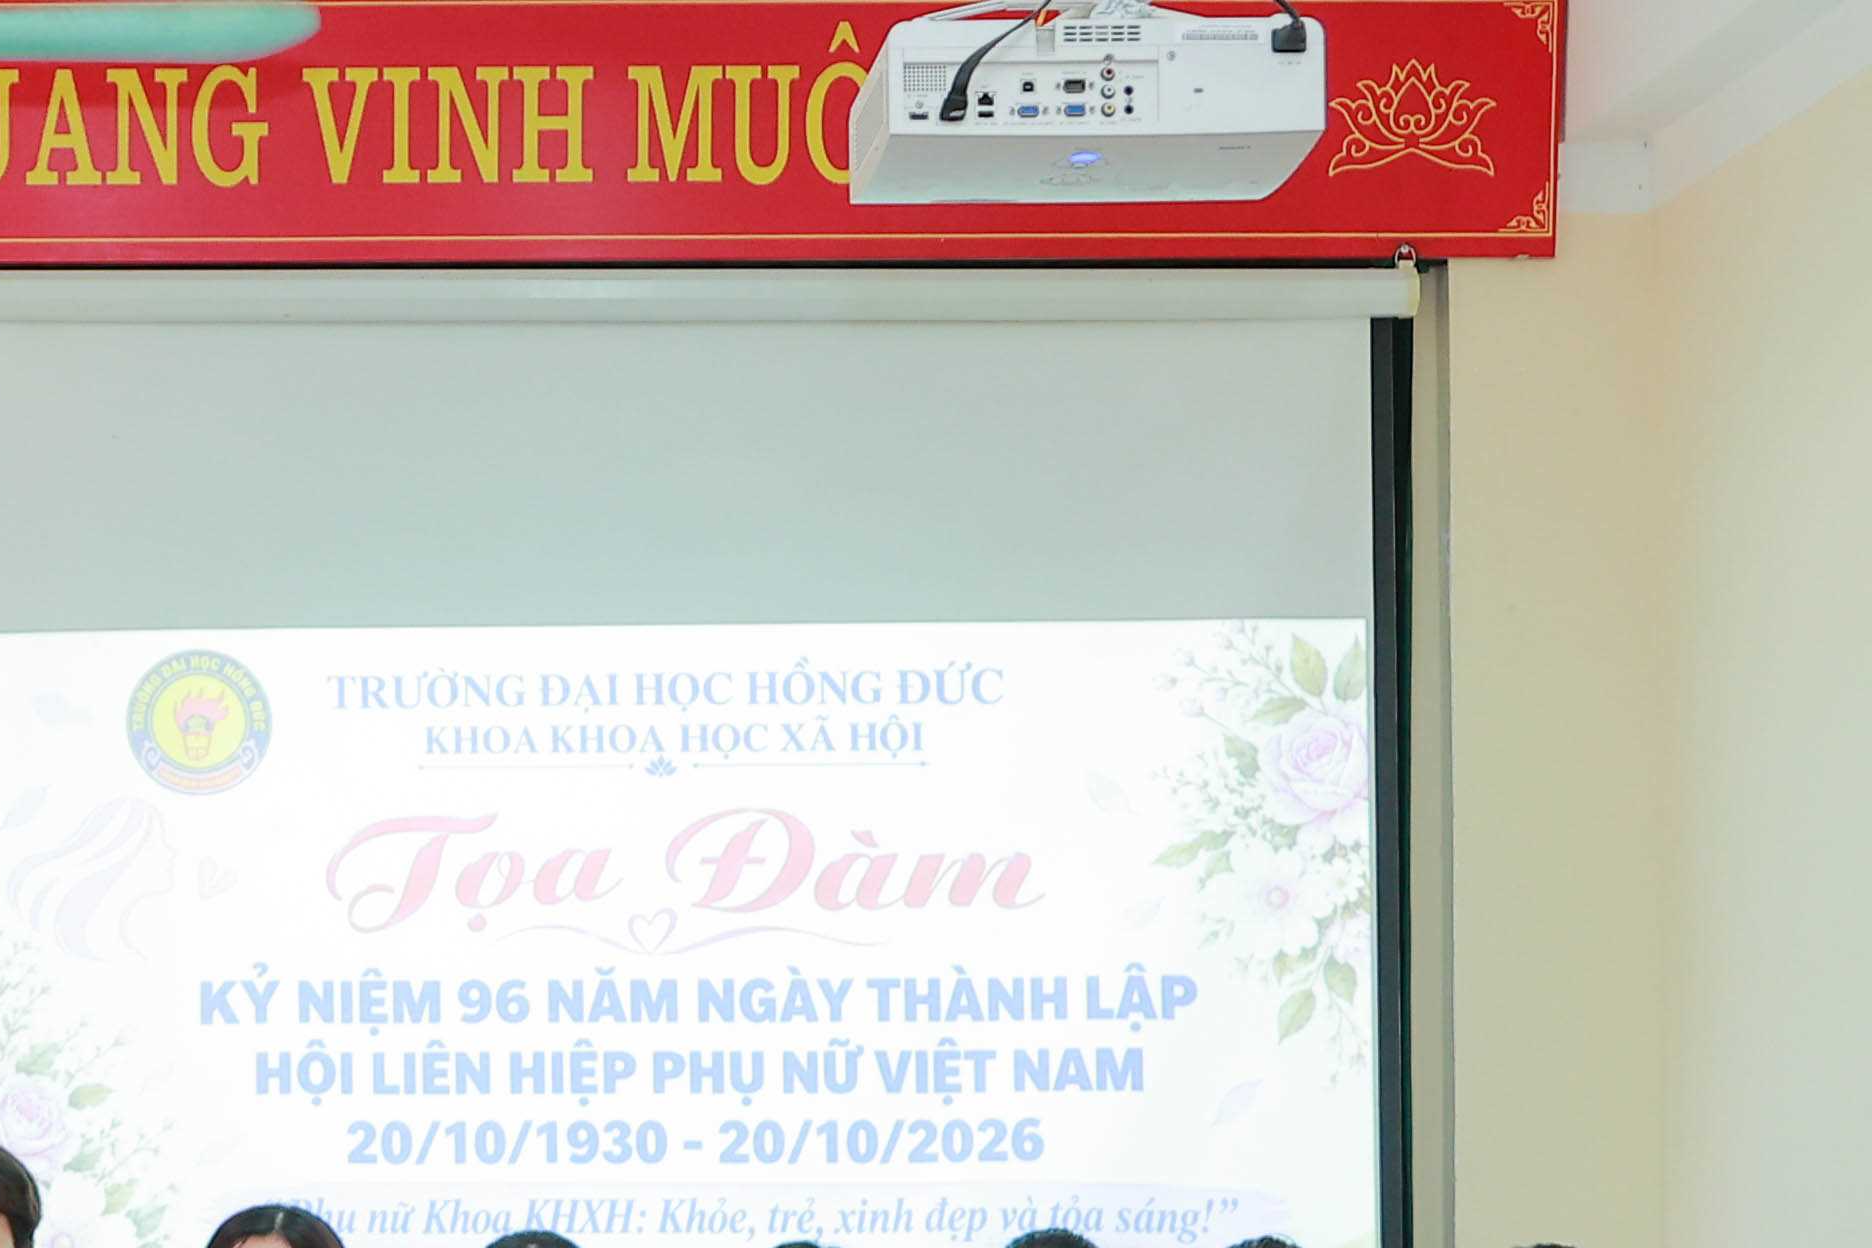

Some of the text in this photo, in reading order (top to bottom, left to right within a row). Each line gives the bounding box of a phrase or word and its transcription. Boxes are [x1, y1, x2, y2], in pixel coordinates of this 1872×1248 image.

[302, 64, 594, 184] VINH
[627, 20, 869, 186] MUÔ
[328, 656, 1005, 715] TRƯỜNG ĐẠI HỌC HỒNG ĐỨC
[425, 714, 925, 760] KHOA KHOA HỌC XÃ HỘI
[326, 807, 1046, 934] Tọa Đàm
[199, 961, 1200, 1037] KỶ NIỆM 96 NĂM NGÀY THÀNH LẬP
[256, 1037, 1146, 1107] HỘI LIÊN HIỆP PHỤ NỮ VIỆT NAM
[346, 1117, 1046, 1166] 20/10/1930 - 20/10/2026
[366, 1202, 416, 1234] nữ
[421, 1197, 513, 1235] Khoa
[523, 1197, 647, 1235] KHXH:
[658, 1197, 756, 1242] Khỏe,
[766, 1197, 824, 1241] trẻ,
[832, 1197, 913, 1235] xinh
[924, 1196, 988, 1242] đẹp
[999, 1195, 1037, 1234] và
[1048, 1194, 1104, 1233] tỏa
